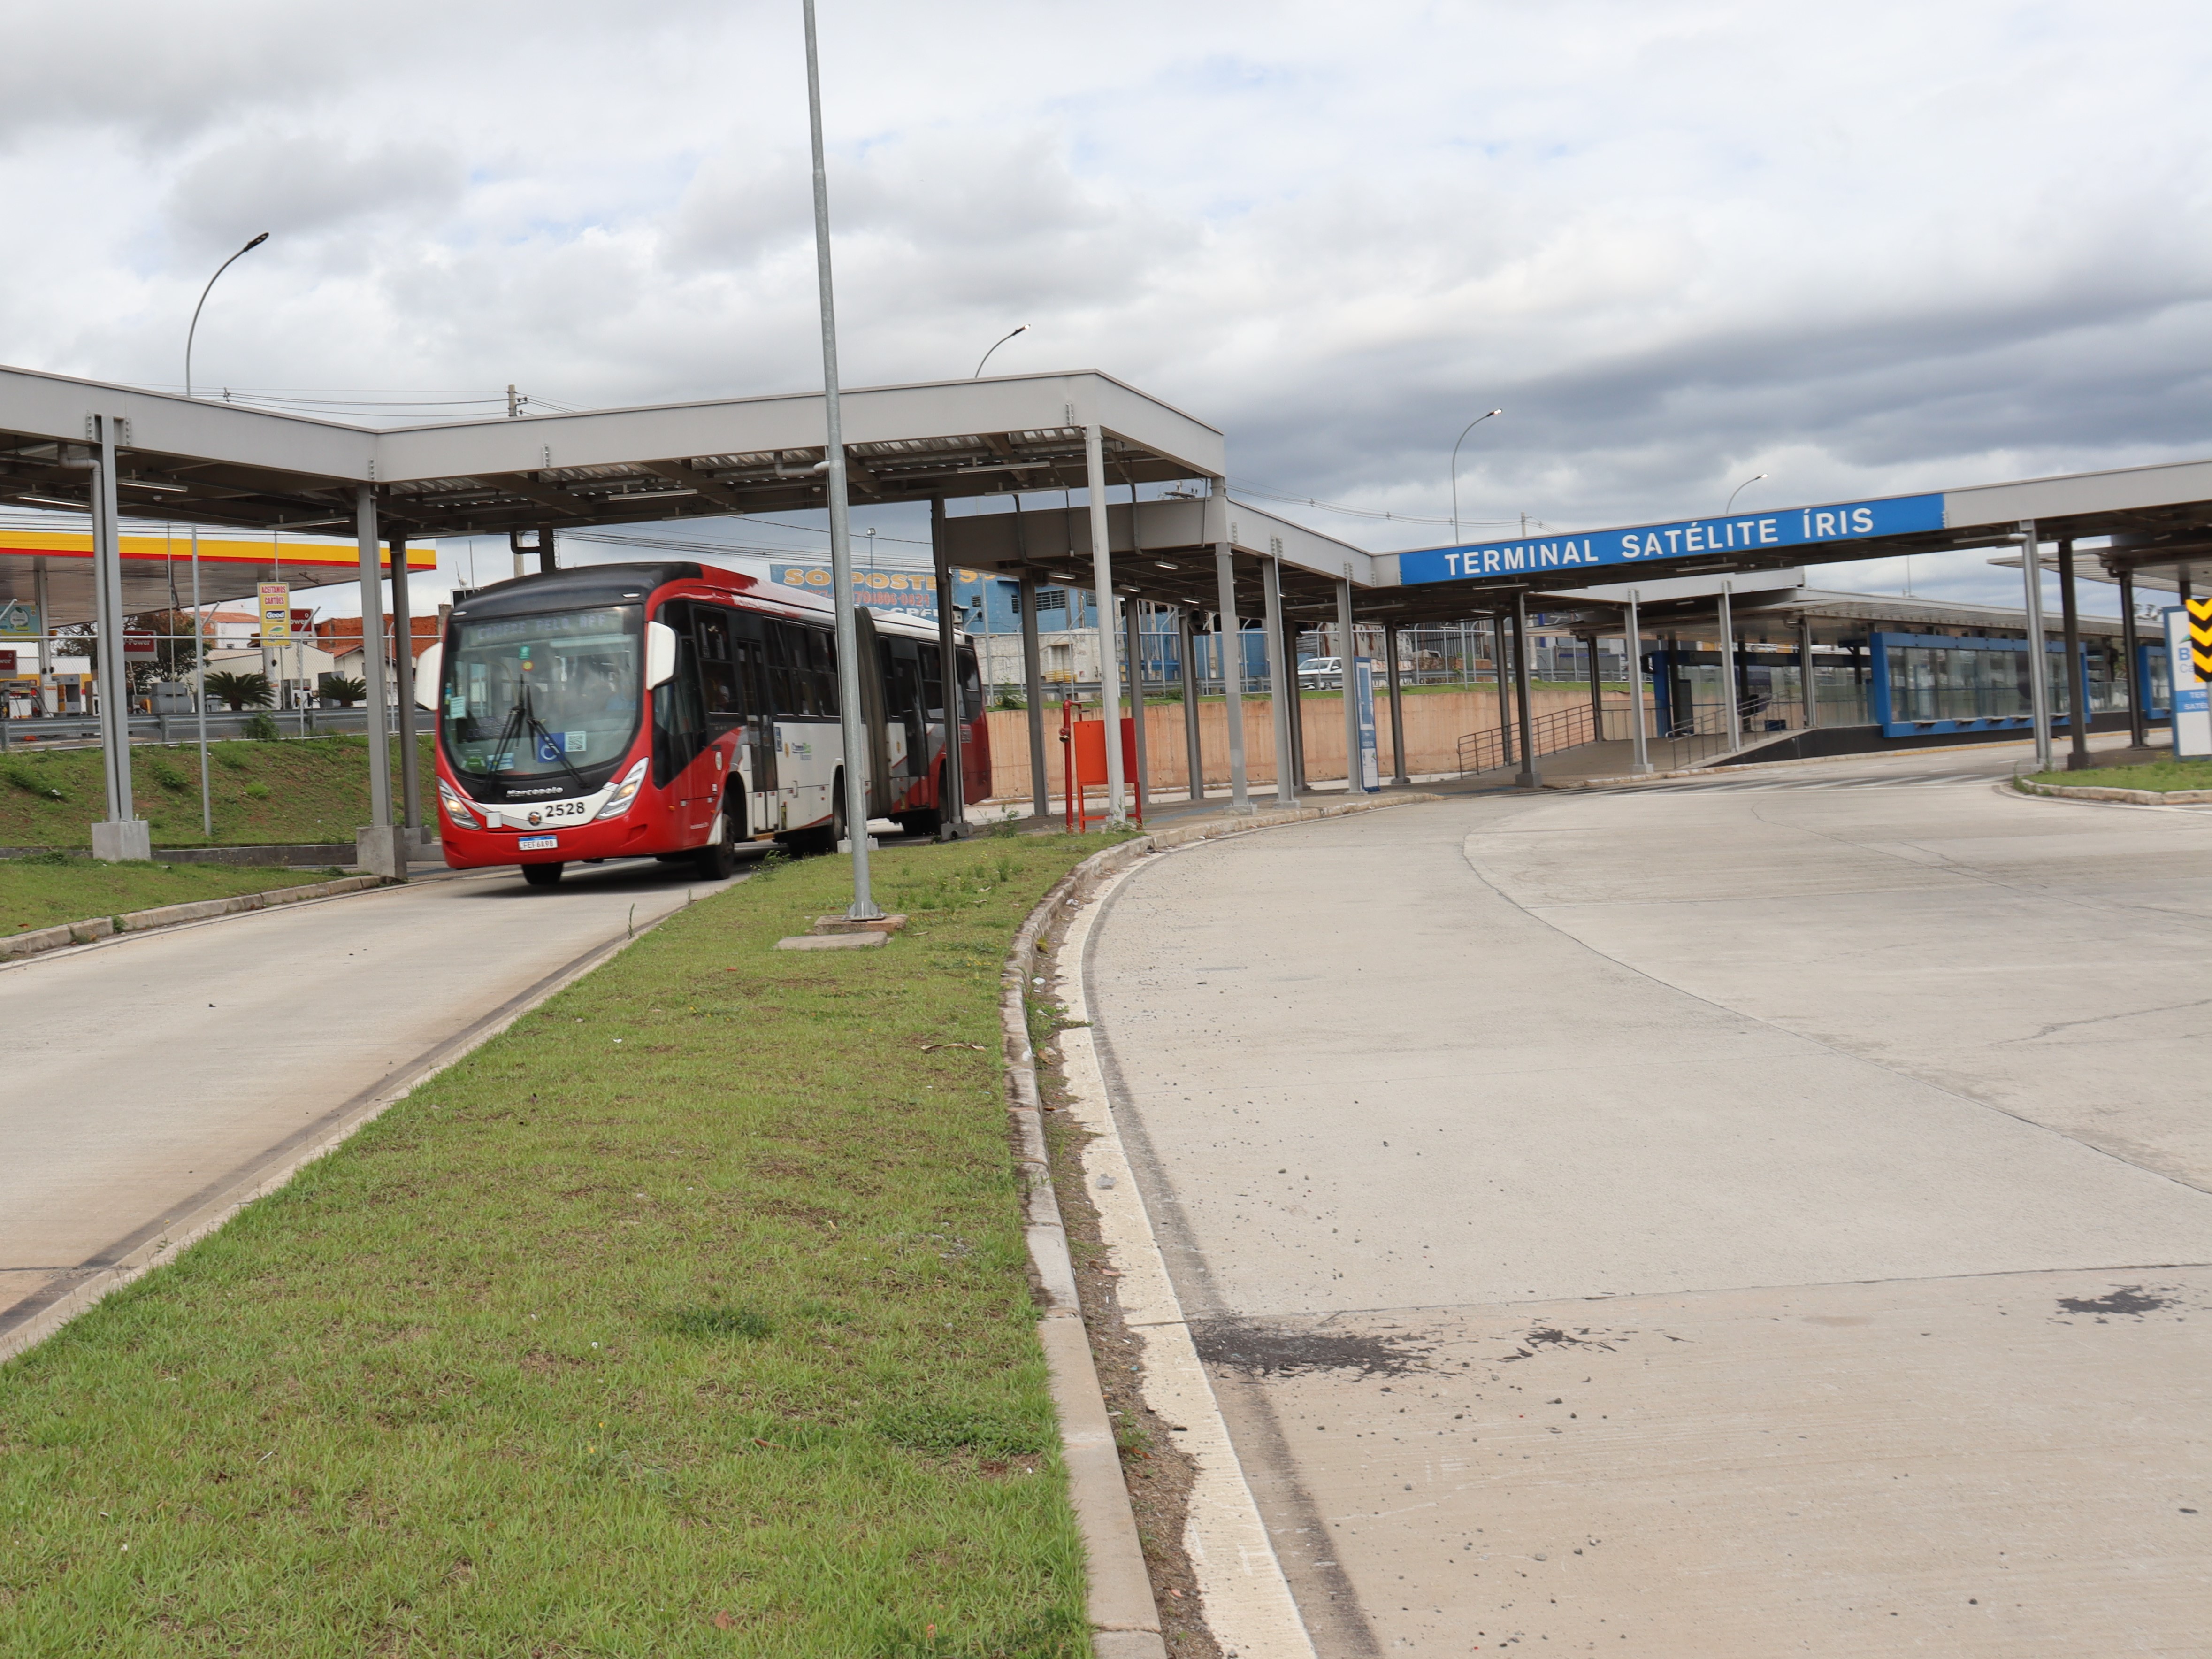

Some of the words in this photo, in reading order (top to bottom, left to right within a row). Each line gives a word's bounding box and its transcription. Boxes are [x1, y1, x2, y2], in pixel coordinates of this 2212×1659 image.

[1444, 539, 1599, 576] TERMINAL
[1622, 518, 1779, 558] SATÉLITE
[1803, 507, 1875, 538] ÍRIS
[783, 567, 832, 586] SÓ
[851, 571, 937, 591] POSTE
[545, 801, 585, 818] 2528
